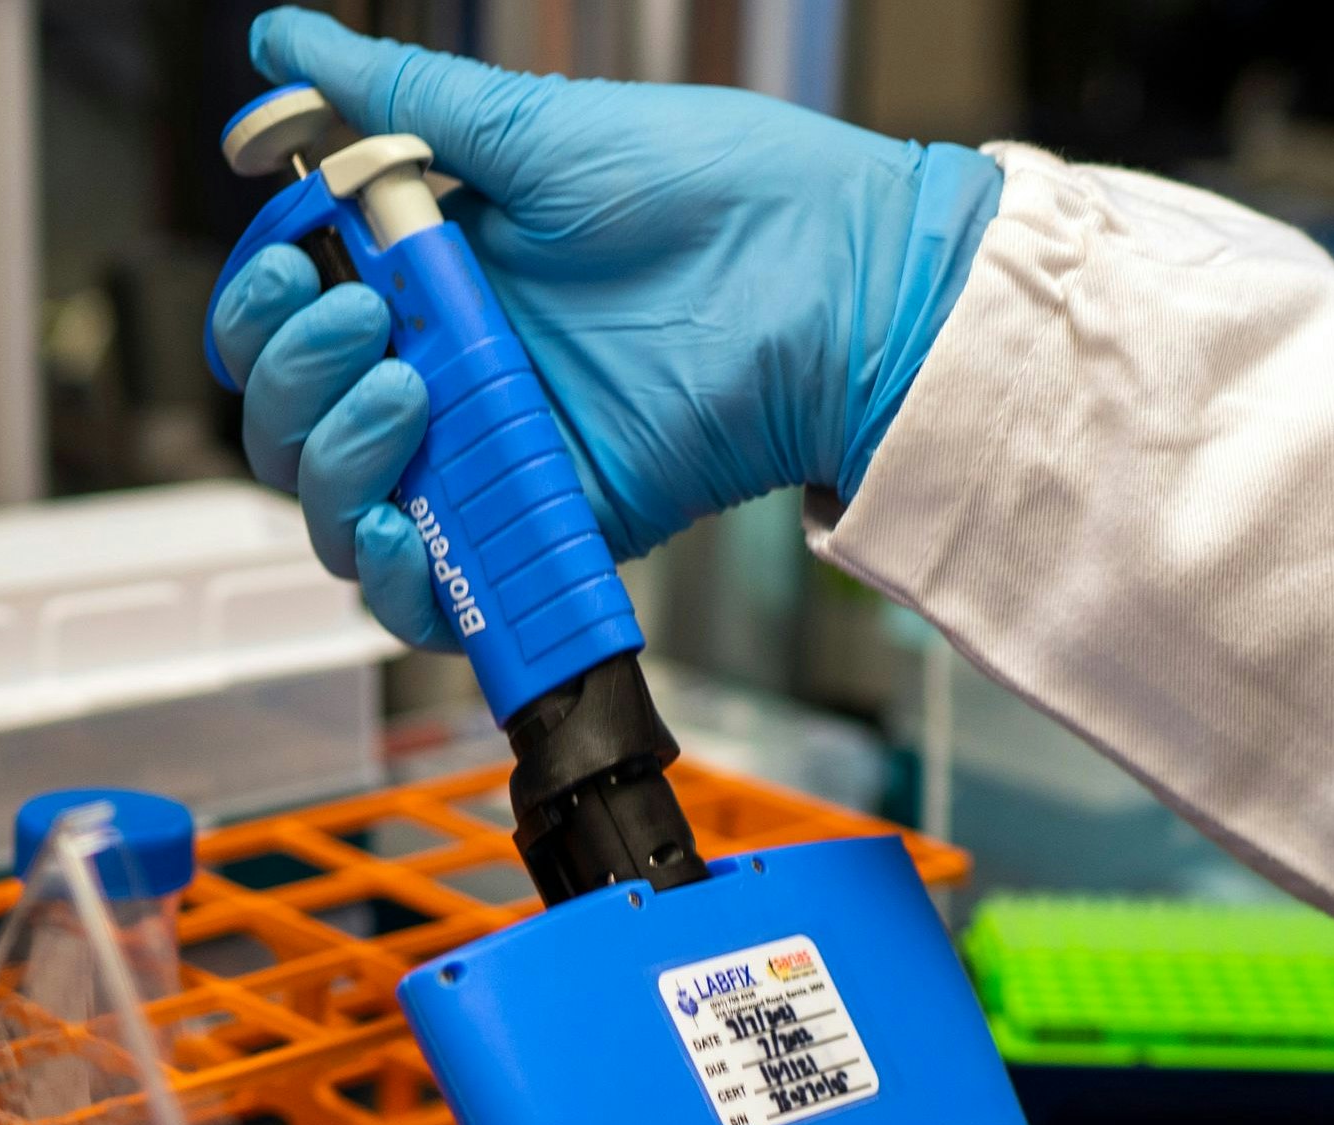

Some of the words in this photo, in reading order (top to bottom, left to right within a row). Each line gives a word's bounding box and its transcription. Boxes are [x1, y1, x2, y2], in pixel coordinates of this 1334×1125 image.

[410, 495, 486, 638] BioPette
[693, 962, 757, 1000] LABFIX
[693, 1032, 722, 1053] DATE
[704, 1060, 730, 1079] DUE
[718, 1081, 747, 1104] CERT
